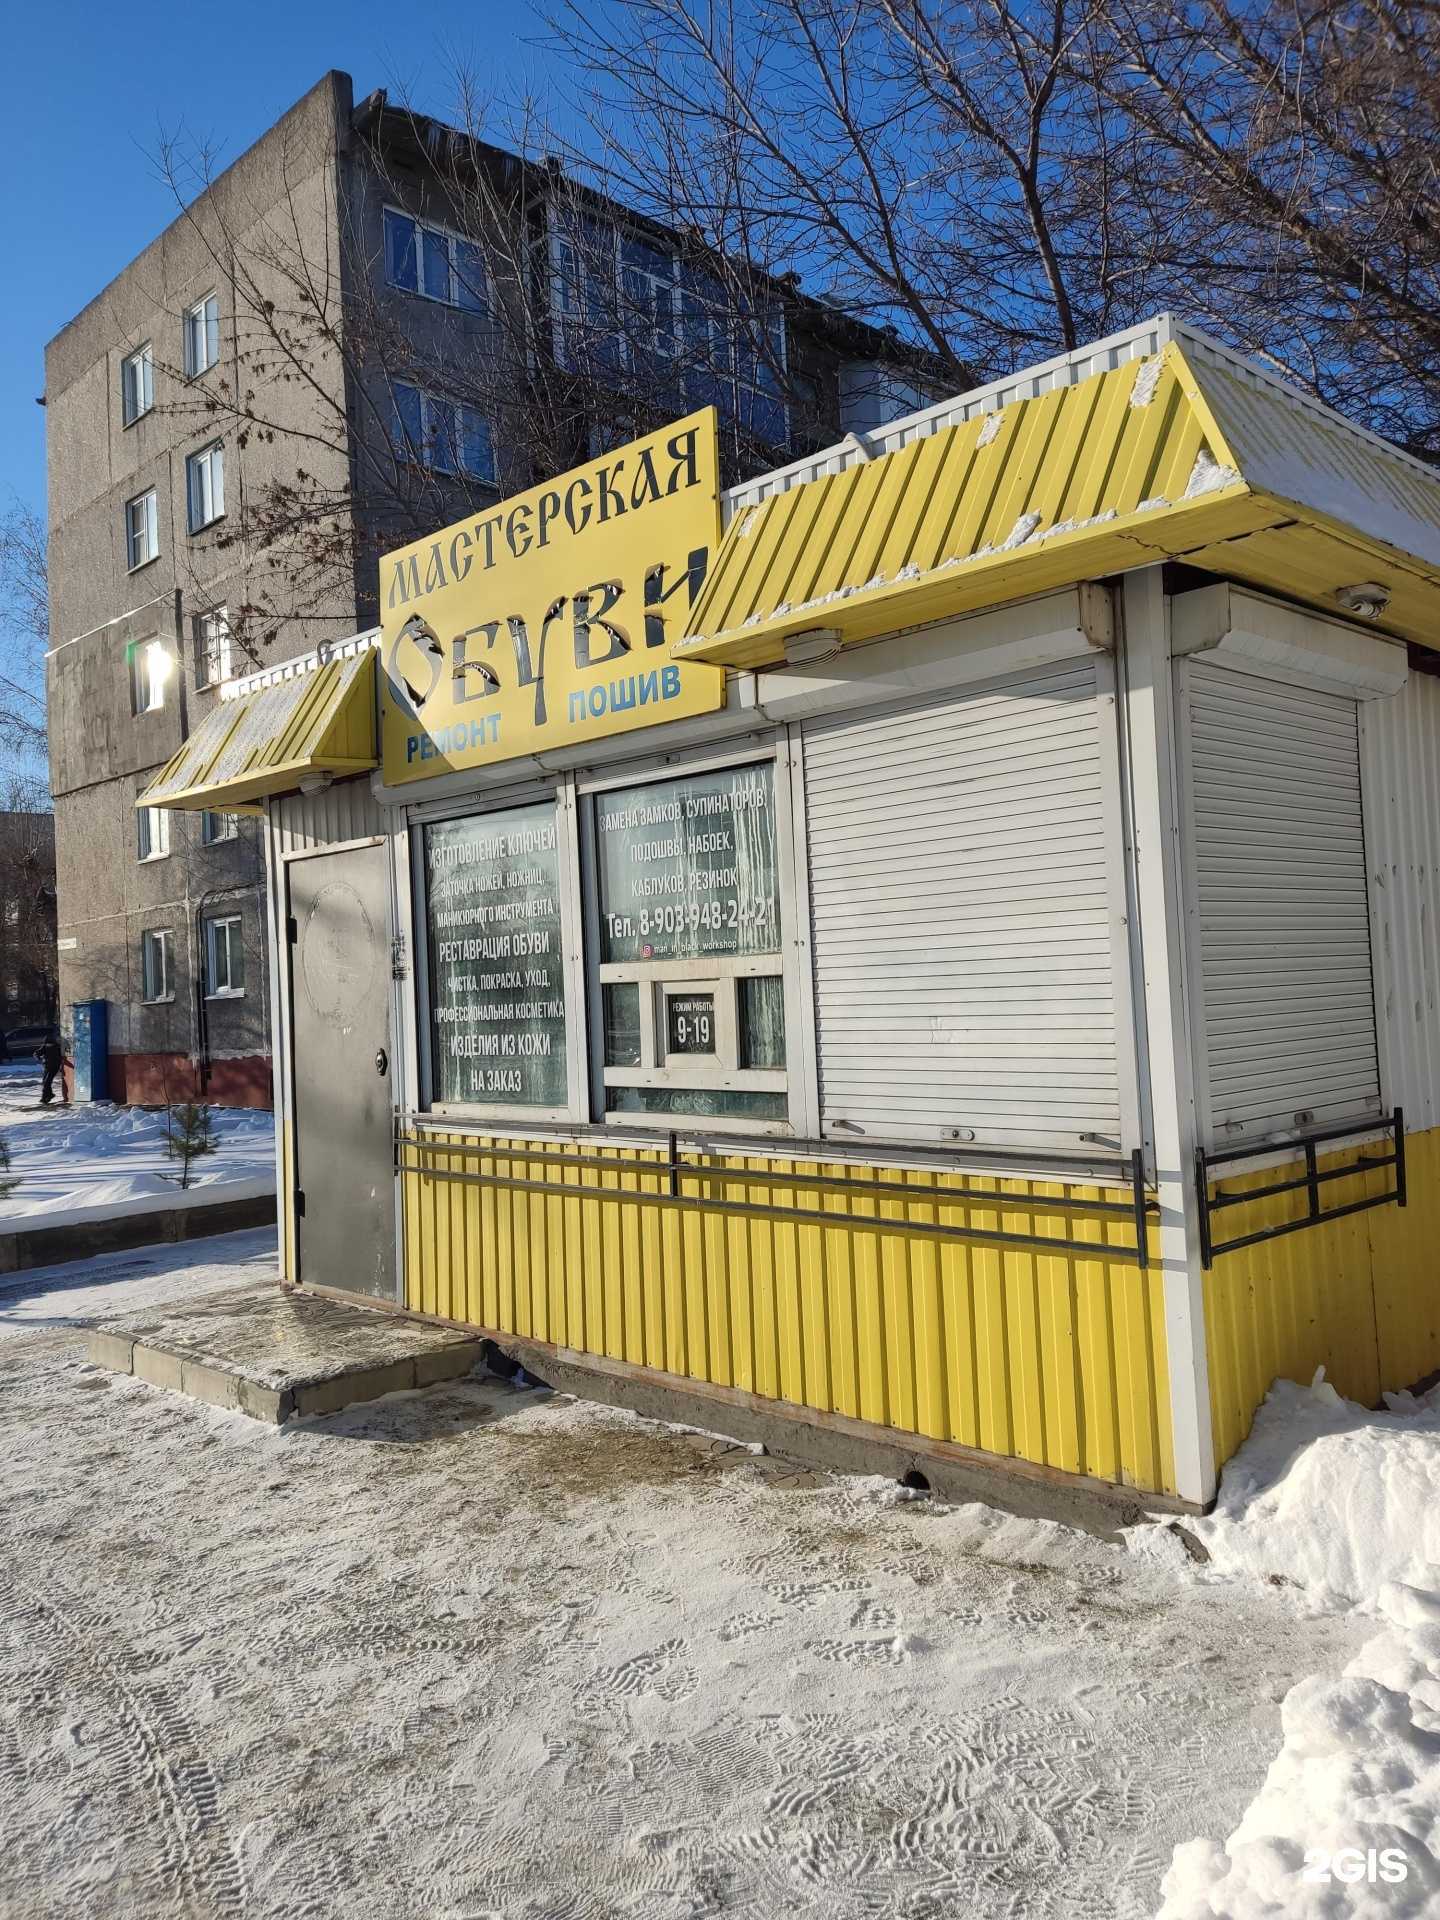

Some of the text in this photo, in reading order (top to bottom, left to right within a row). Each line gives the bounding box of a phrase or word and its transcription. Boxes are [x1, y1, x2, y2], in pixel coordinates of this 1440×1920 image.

[389, 427, 701, 608] МАСТЕРСКАЯ
[408, 664, 681, 763] РЕМОНТ ПОШИВ
[600, 808, 638, 832] ЗАМЕНА
[430, 824, 555, 869] ИЗГОТОВЛЕНИЕ КЛЮЧЕЙ
[441, 877, 474, 897] ЗАТОЧКА
[689, 868, 737, 890] РЕЗИНОК
[437, 897, 553, 928] МАНИКЮРНОГО ИНСТРУМЕНТА
[607, 913, 636, 939] Тел.
[440, 931, 549, 962] РЕСТАВРАЦИЯ ОБУВИ
[480, 971, 524, 990] ПОКРАСКА,
[434, 1004, 513, 1023] ПРОФЕССИОНАЛЬНАЯ
[678, 1016, 710, 1043] 9-19
[451, 1034, 550, 1058] ИЗДЕЛИЯ ИЗ КОЖИ
[471, 1070, 521, 1091] НА ЗАКАЗ
